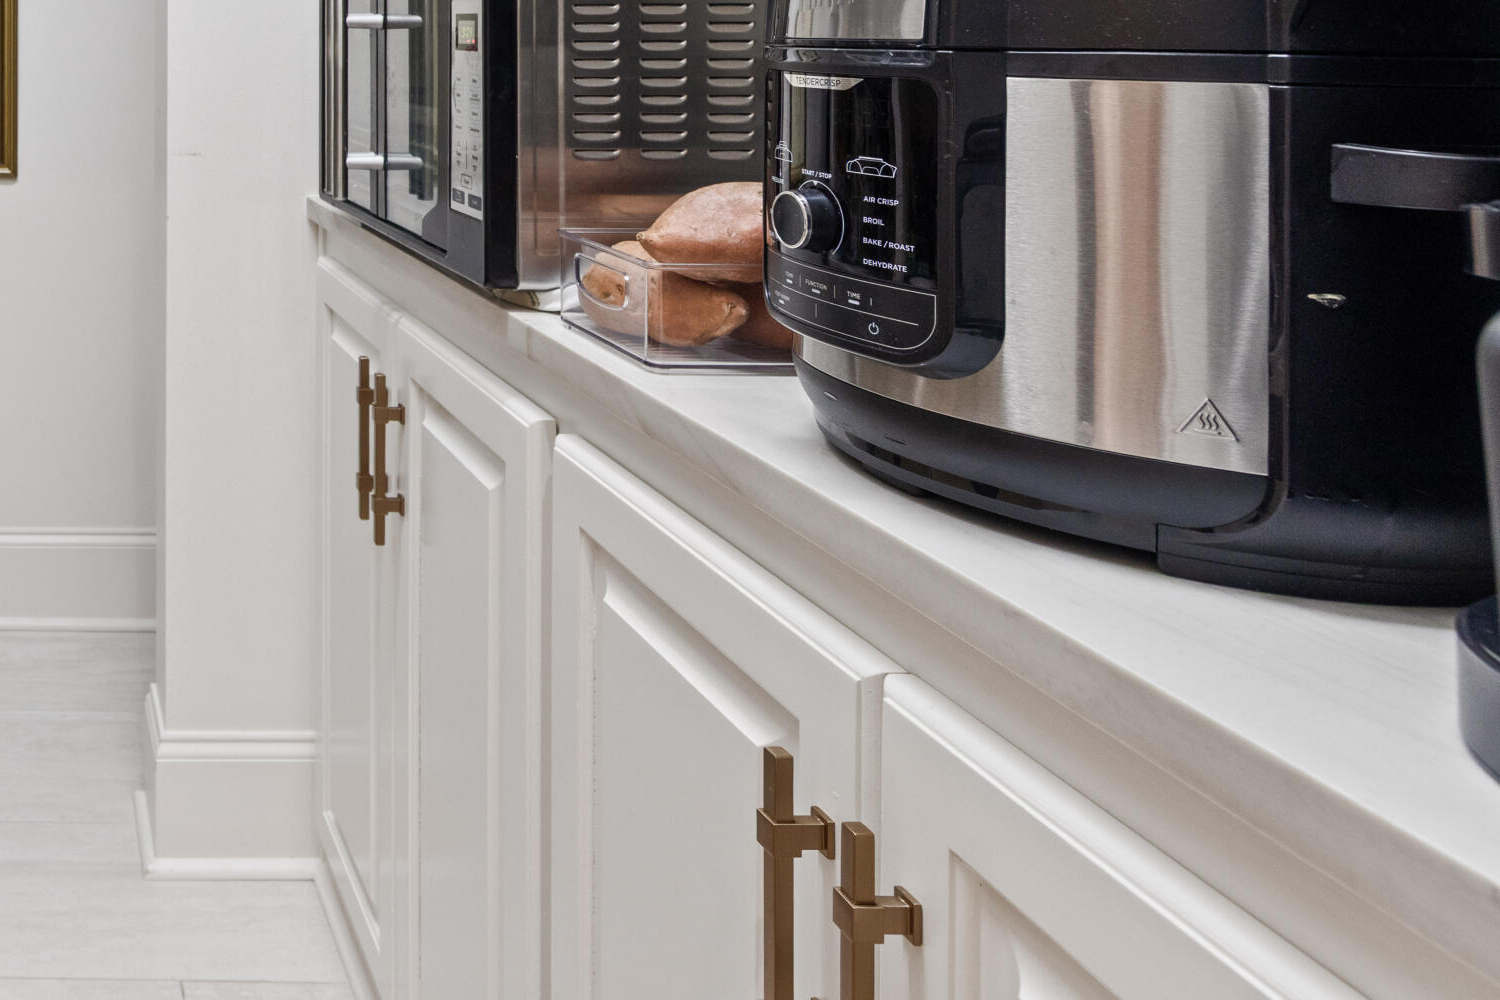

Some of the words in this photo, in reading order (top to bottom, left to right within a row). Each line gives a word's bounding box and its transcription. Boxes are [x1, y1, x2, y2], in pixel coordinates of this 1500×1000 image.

[796, 76, 841, 87] TENDERCRISP
[802, 168, 815, 177] START
[818, 170, 832, 179] STOP
[863, 196, 876, 204] AIR
[877, 196, 899, 206] CRISP
[862, 216, 885, 226] BROIL
[862, 237, 882, 248] BAKE
[888, 241, 916, 252] ROAST
[862, 258, 908, 273] DEHYDRATE
[805, 279, 828, 290] FUNCTION
[847, 290, 861, 300] TIME
